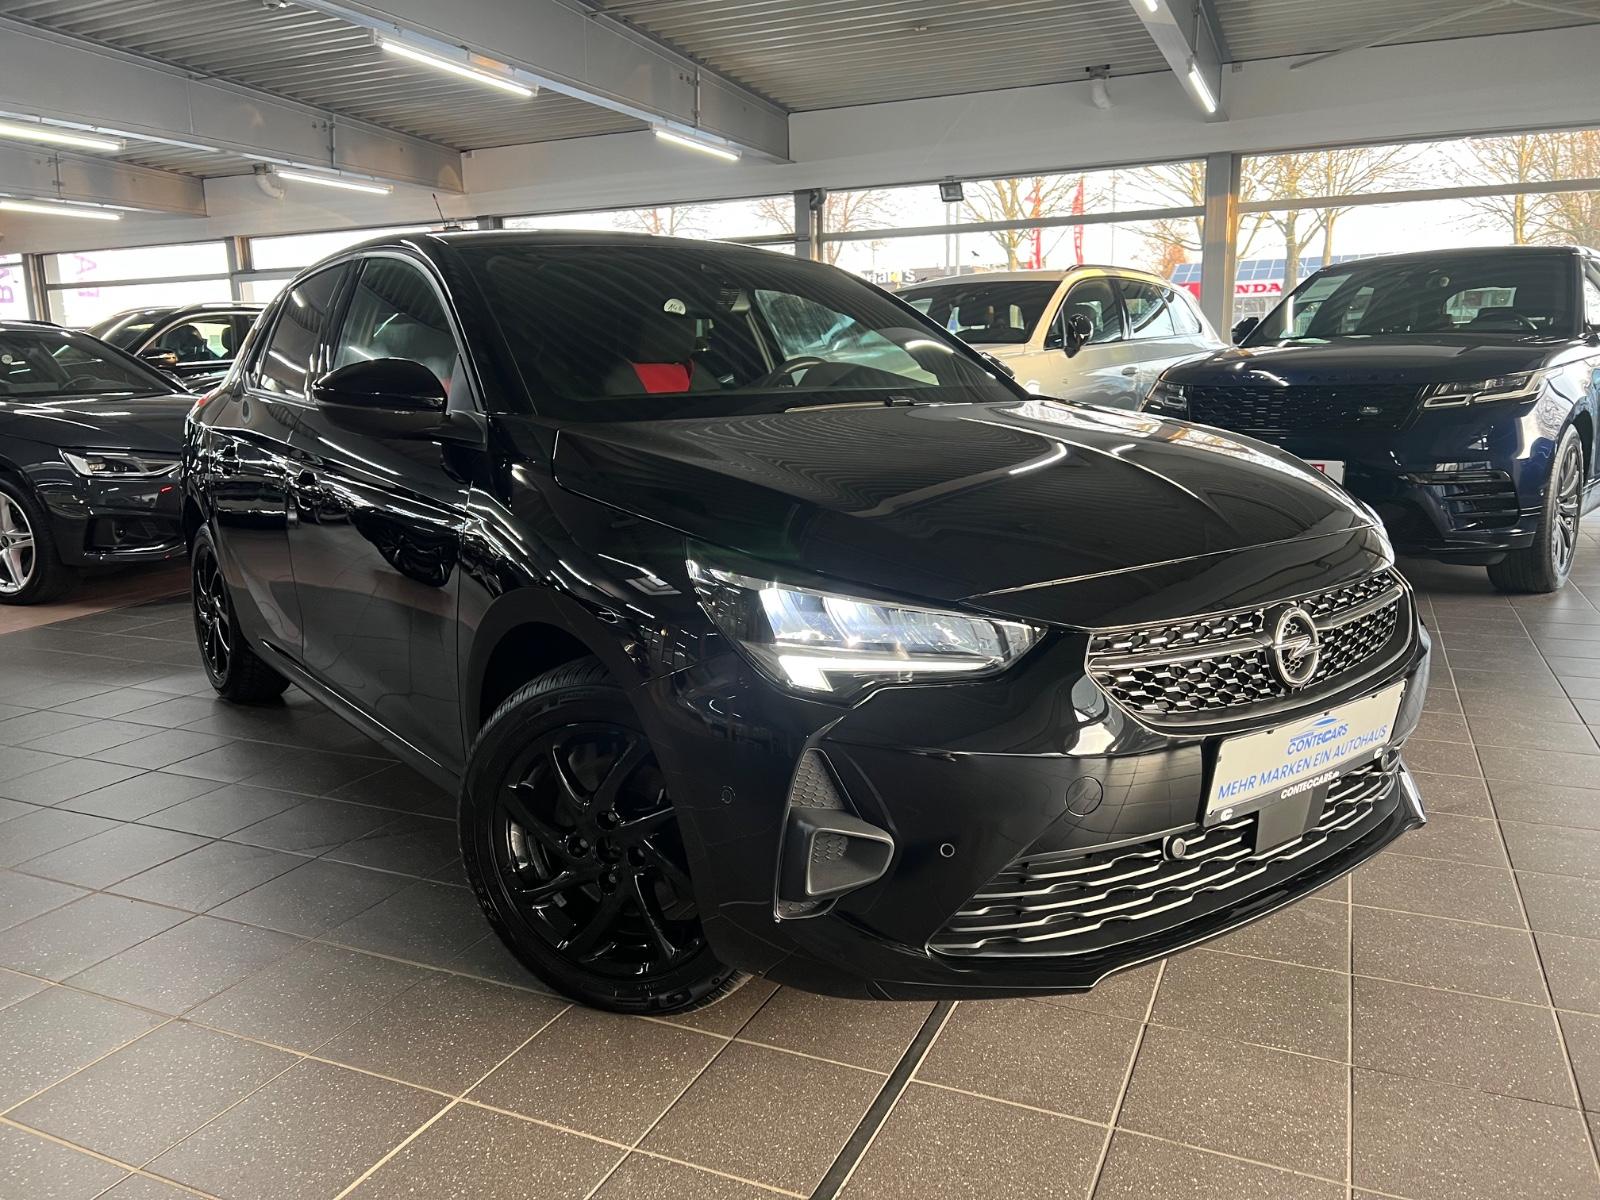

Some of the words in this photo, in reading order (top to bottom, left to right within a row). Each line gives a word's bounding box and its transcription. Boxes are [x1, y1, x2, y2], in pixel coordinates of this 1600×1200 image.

[1235, 282, 1282, 294] NDA
[1217, 775, 1257, 800] MEHR
[1259, 757, 1313, 787] MARKEN
[1313, 749, 1332, 767] EIN
[1332, 724, 1388, 758] AUTOHAUS
